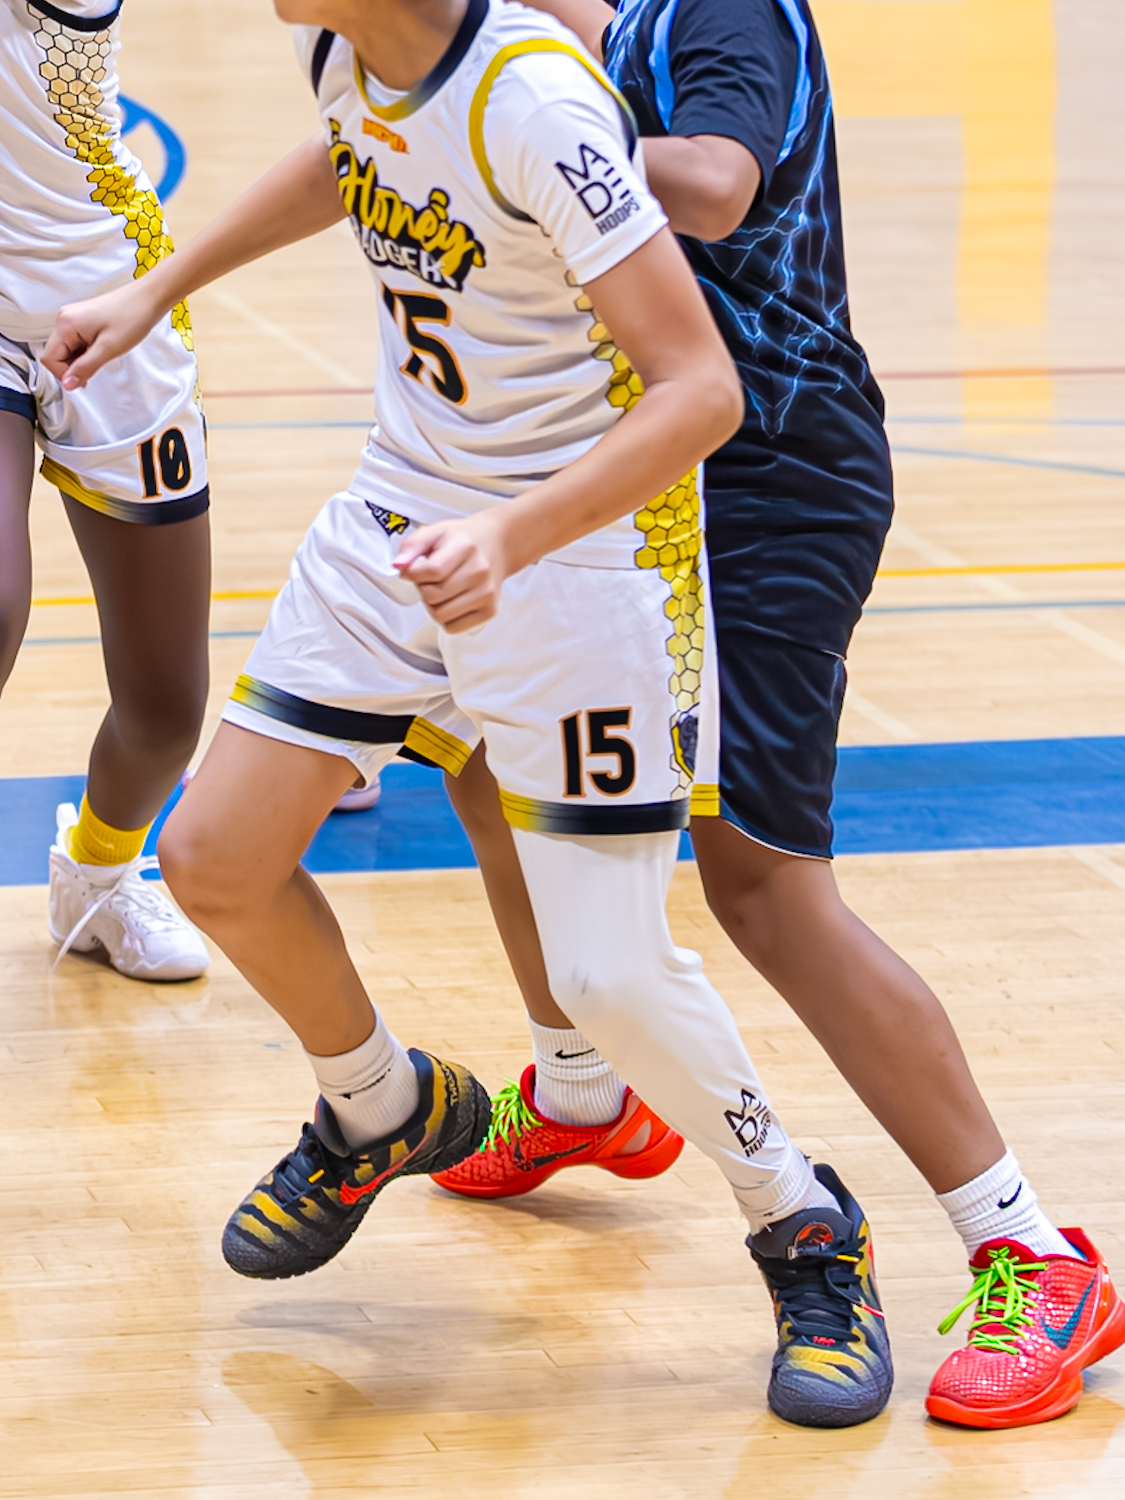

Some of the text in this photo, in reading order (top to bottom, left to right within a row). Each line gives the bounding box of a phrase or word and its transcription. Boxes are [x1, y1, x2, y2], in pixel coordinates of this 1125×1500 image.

[328, 118, 487, 276] Honey
[595, 197, 641, 235] HOOPS
[137, 426, 192, 499] 10
[559, 706, 636, 799] 15
